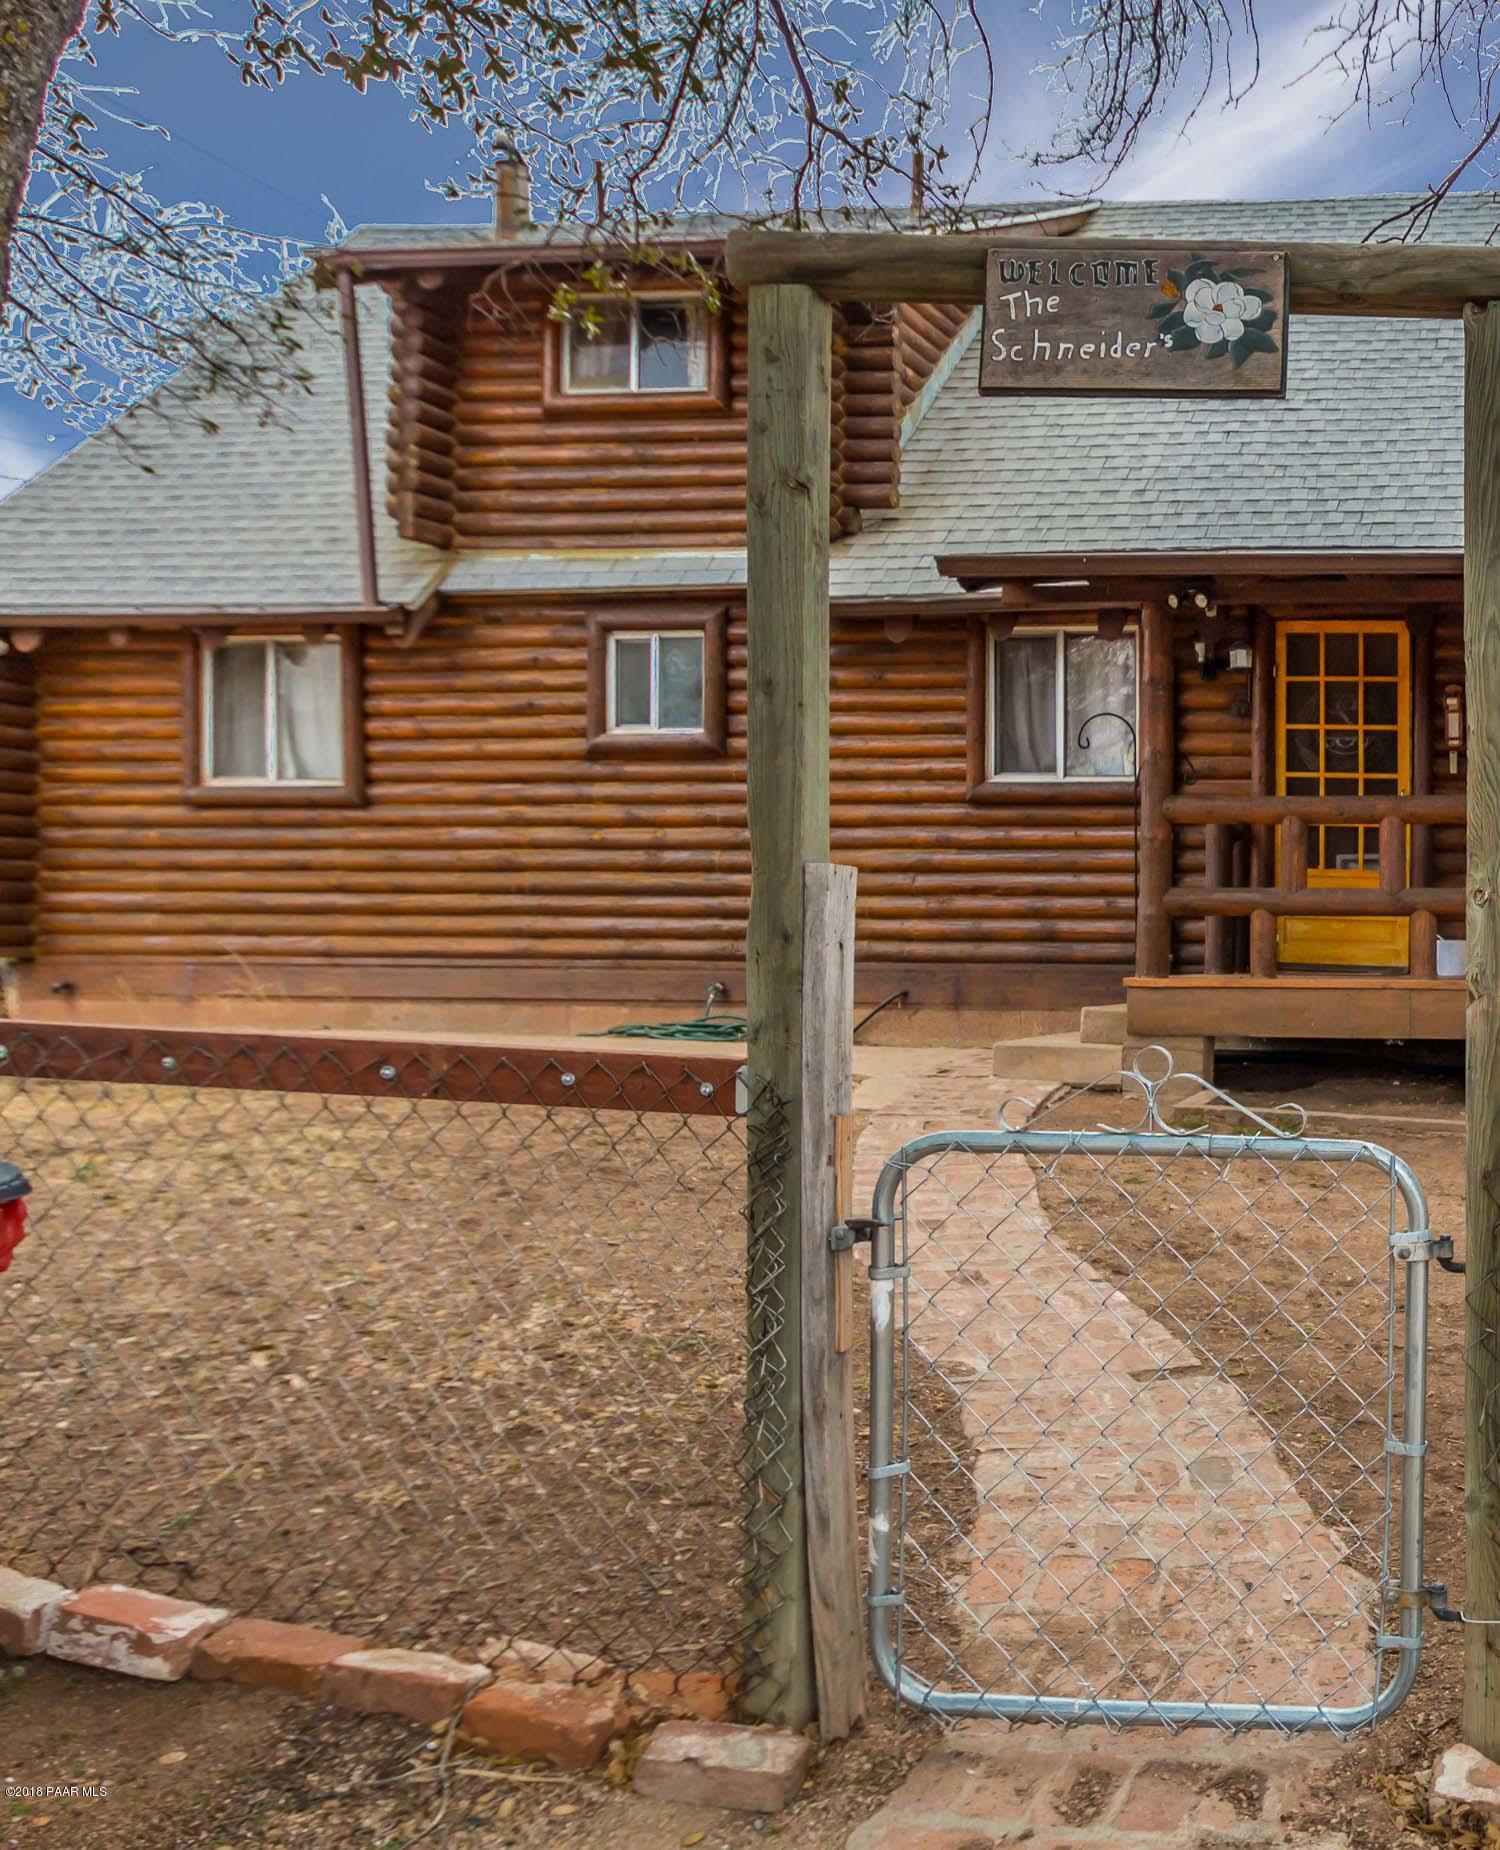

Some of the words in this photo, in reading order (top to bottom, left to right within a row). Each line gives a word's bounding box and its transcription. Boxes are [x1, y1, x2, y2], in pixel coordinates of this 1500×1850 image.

[997, 258, 1161, 288] WELCOME
[999, 289, 1060, 320] The
[991, 328, 1174, 362] Schneider's
